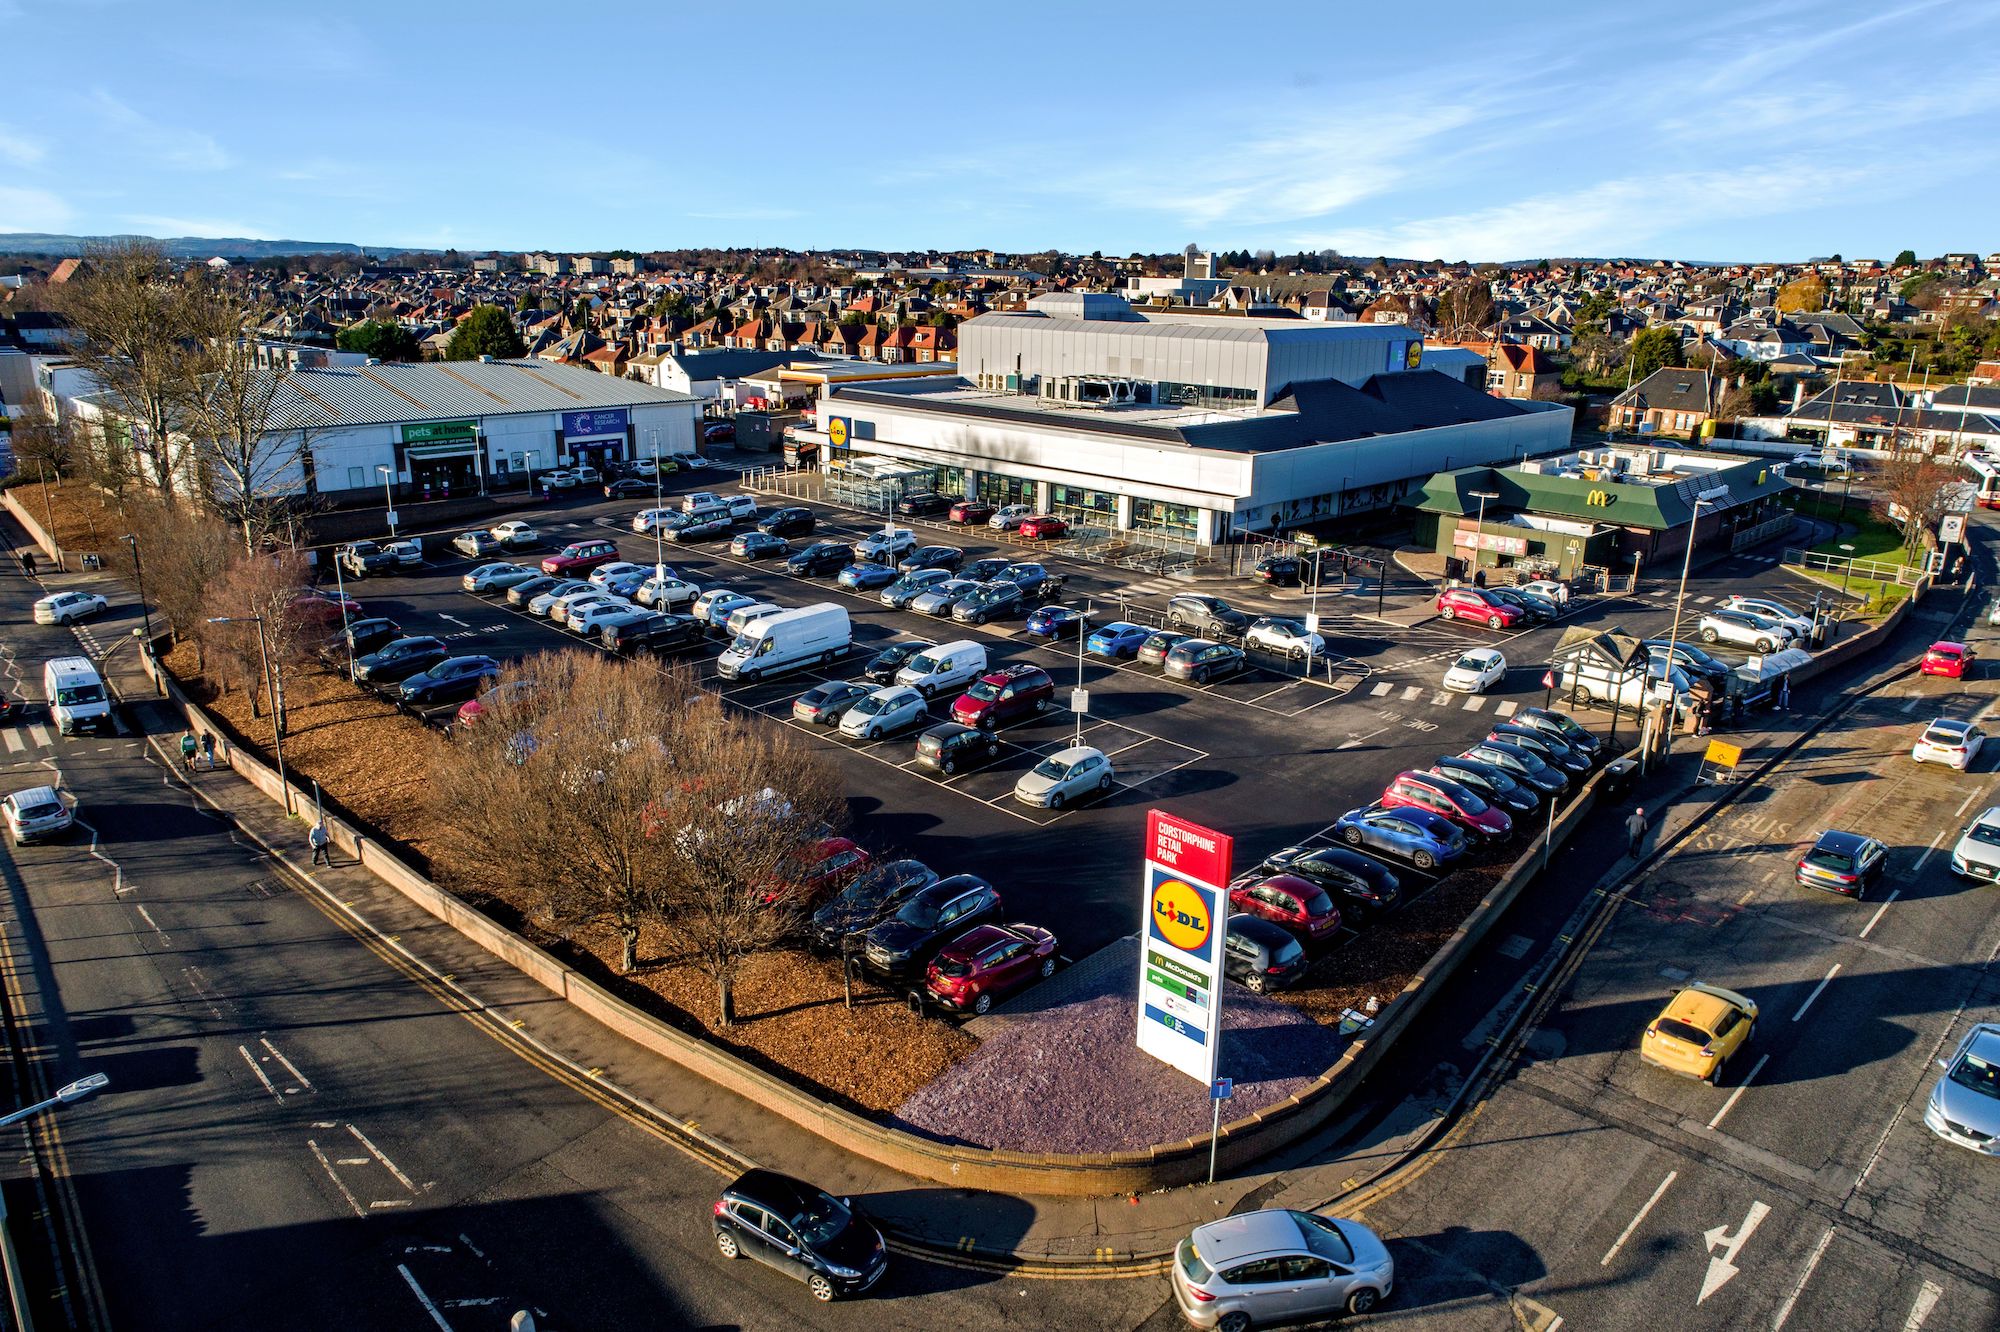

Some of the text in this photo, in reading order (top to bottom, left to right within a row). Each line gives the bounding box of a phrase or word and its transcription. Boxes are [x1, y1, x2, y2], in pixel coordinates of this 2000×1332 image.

[408, 424, 471, 439] pets at home
[480, 623, 509, 633] WAY
[1731, 812, 1793, 840] BUS
[1157, 834, 1183, 854] RETAIL
[1158, 821, 1216, 854] CORSTORPHINE
[1157, 847, 1178, 865] PARK
[1151, 974, 1164, 984] pets
